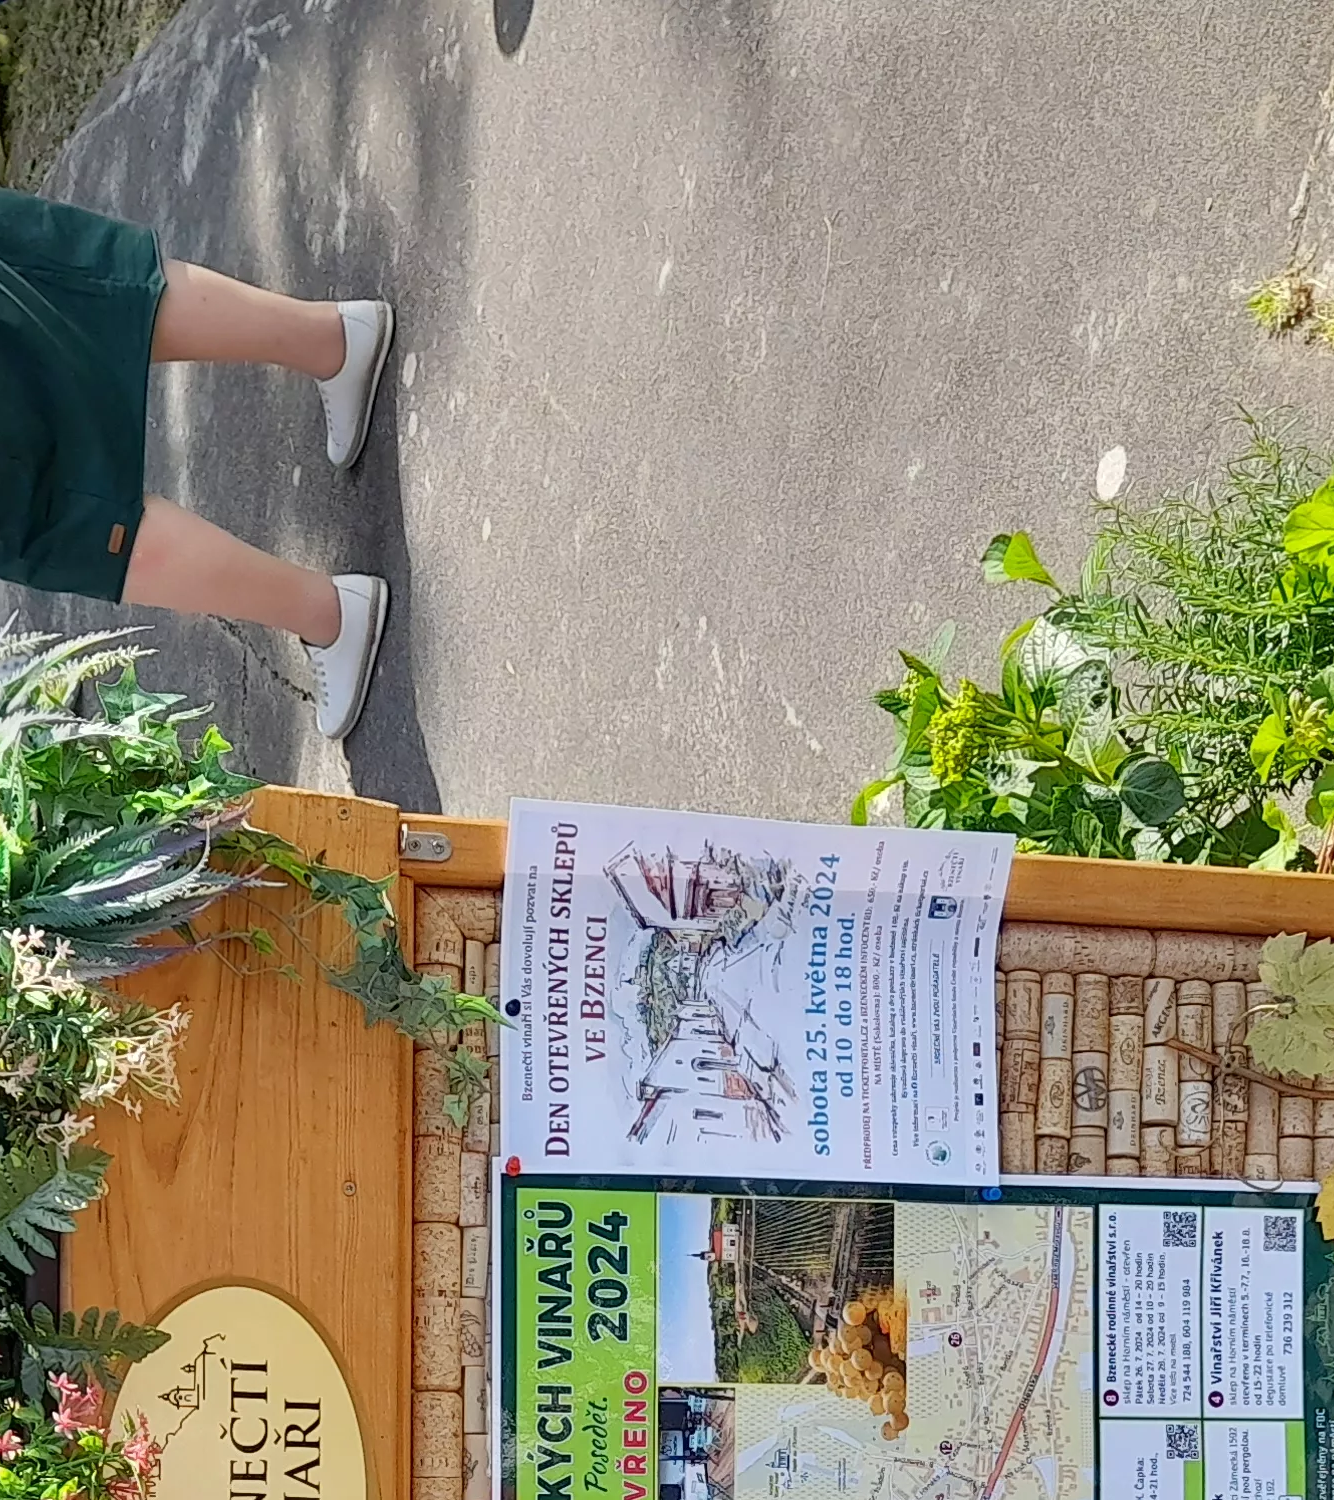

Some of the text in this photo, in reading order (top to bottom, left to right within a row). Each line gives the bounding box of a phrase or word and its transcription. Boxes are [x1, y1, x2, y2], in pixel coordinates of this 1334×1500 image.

[527, 865, 538, 880] na
[525, 882, 538, 924] pozvat
[521, 925, 537, 975] dovolují
[521, 977, 533, 998] Vás
[803, 852, 841, 1157] sobota 25. května 2024
[833, 912, 857, 1098] od 10 do 18 hod.
[521, 1013, 533, 1048] vinaři
[521, 1050, 534, 1102] Bzenečtí
[523, 1200, 573, 1369] VINAŘŮ
[586, 1210, 630, 1343] 2024
[1209, 1230, 1224, 1293] Křivánek
[1106, 1332, 1117, 1383] Bzenecké
[1209, 1320, 1223, 1385] Vinařství
[582, 1396, 609, 1492] Posedět.
